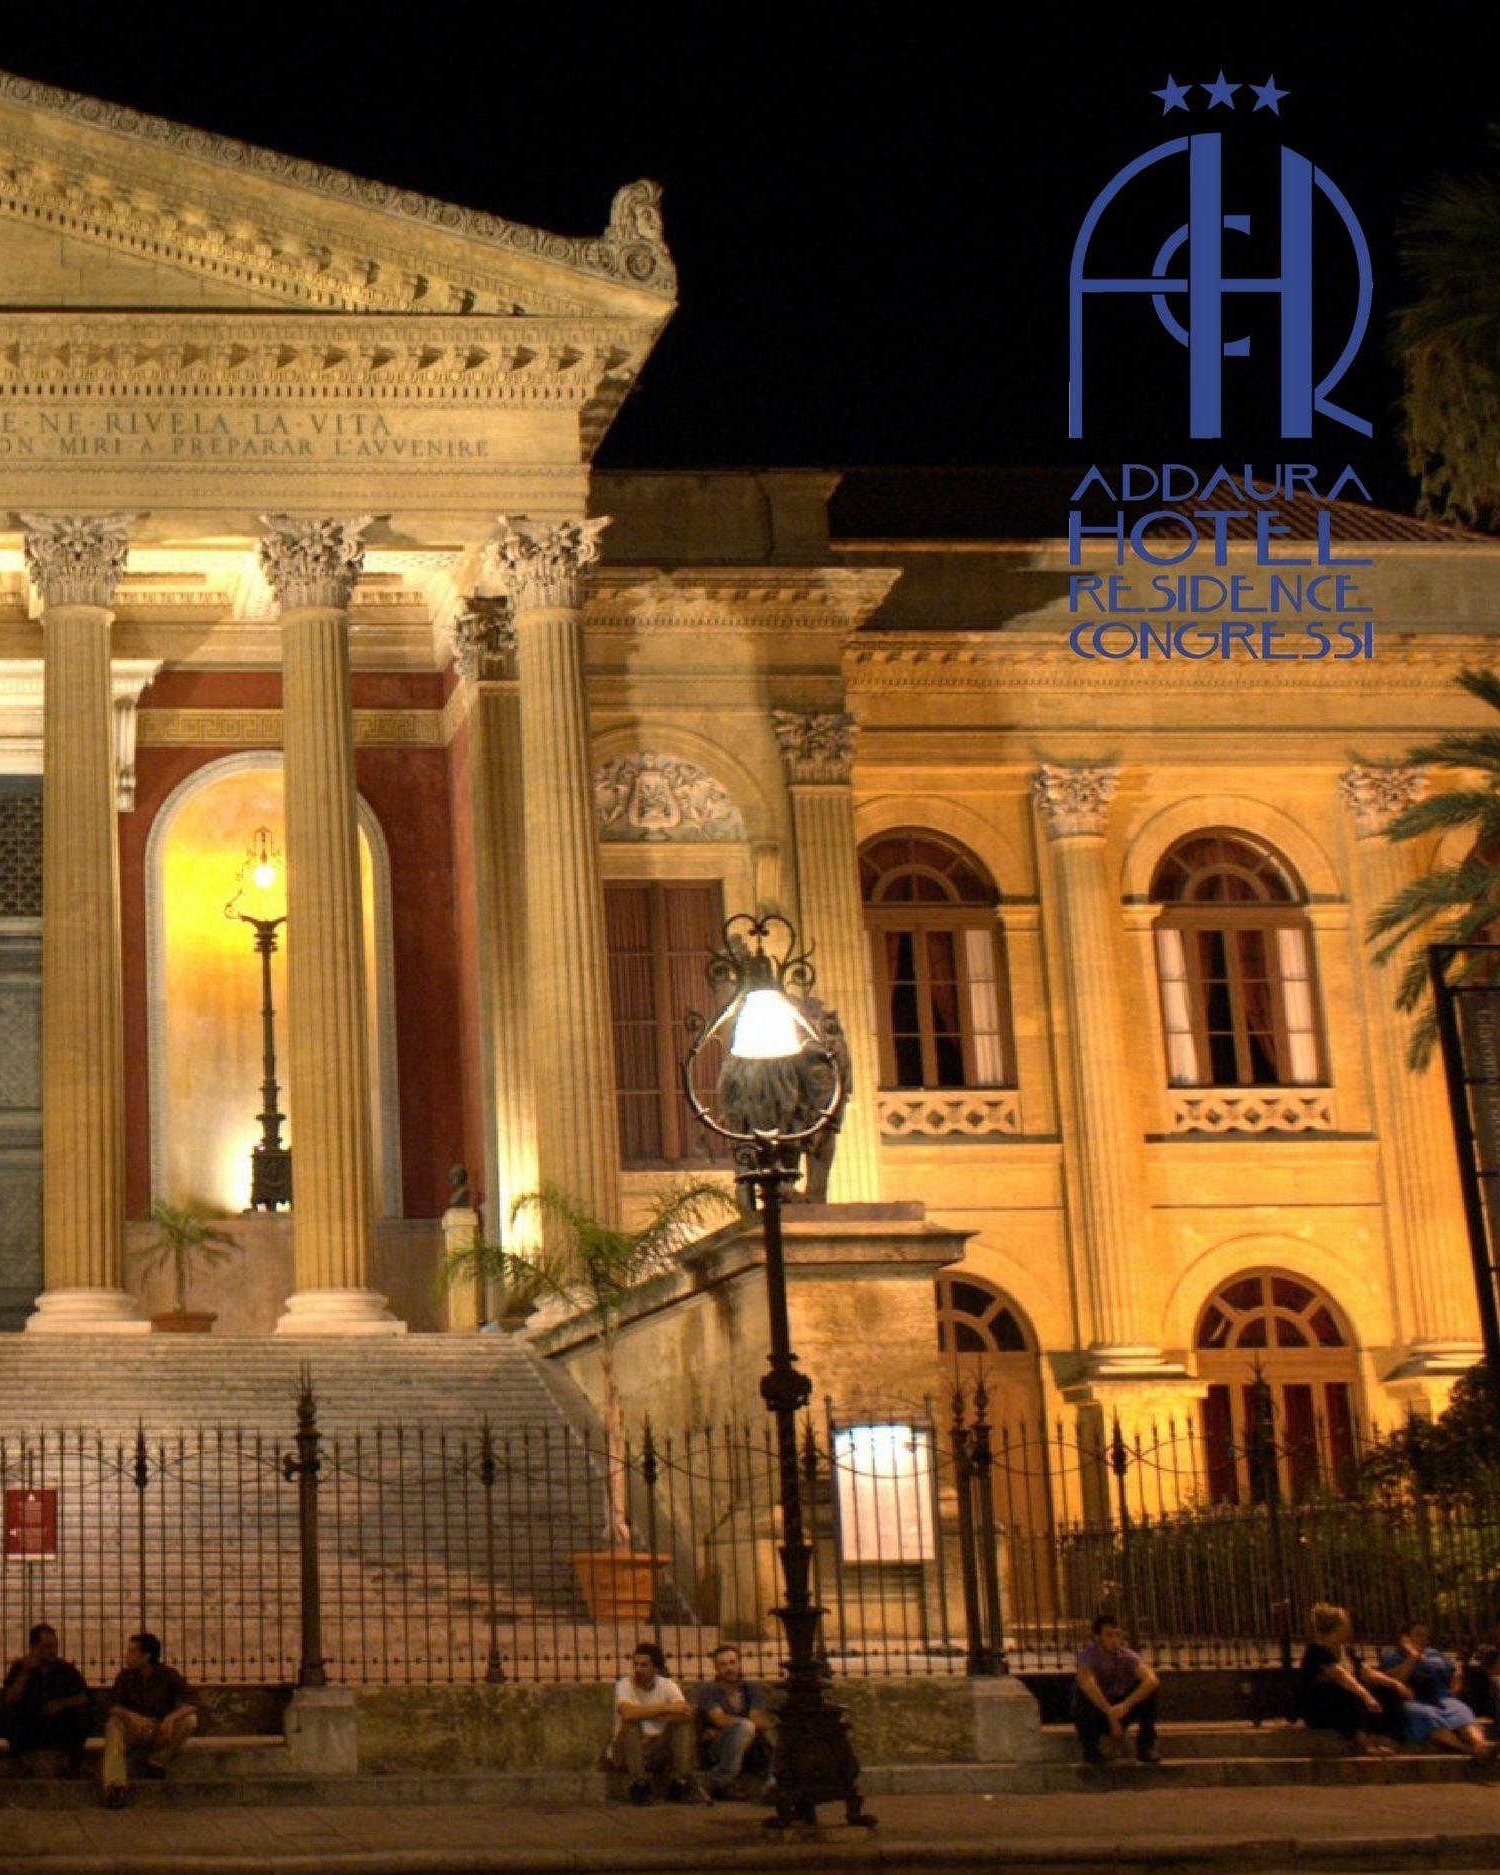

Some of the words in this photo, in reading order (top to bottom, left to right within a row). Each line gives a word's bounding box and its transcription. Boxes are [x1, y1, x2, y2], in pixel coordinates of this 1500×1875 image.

[2, 412, 16, 434] E
[39, 412, 83, 434] NE
[105, 412, 230, 435] RIVELA
[253, 413, 292, 435] LA
[310, 413, 392, 436] VITA
[60, 436, 121, 455] MIRI
[140, 437, 156, 455] A
[173, 437, 315, 457] PREPARAR
[335, 438, 489, 457] L'AVVENIRE
